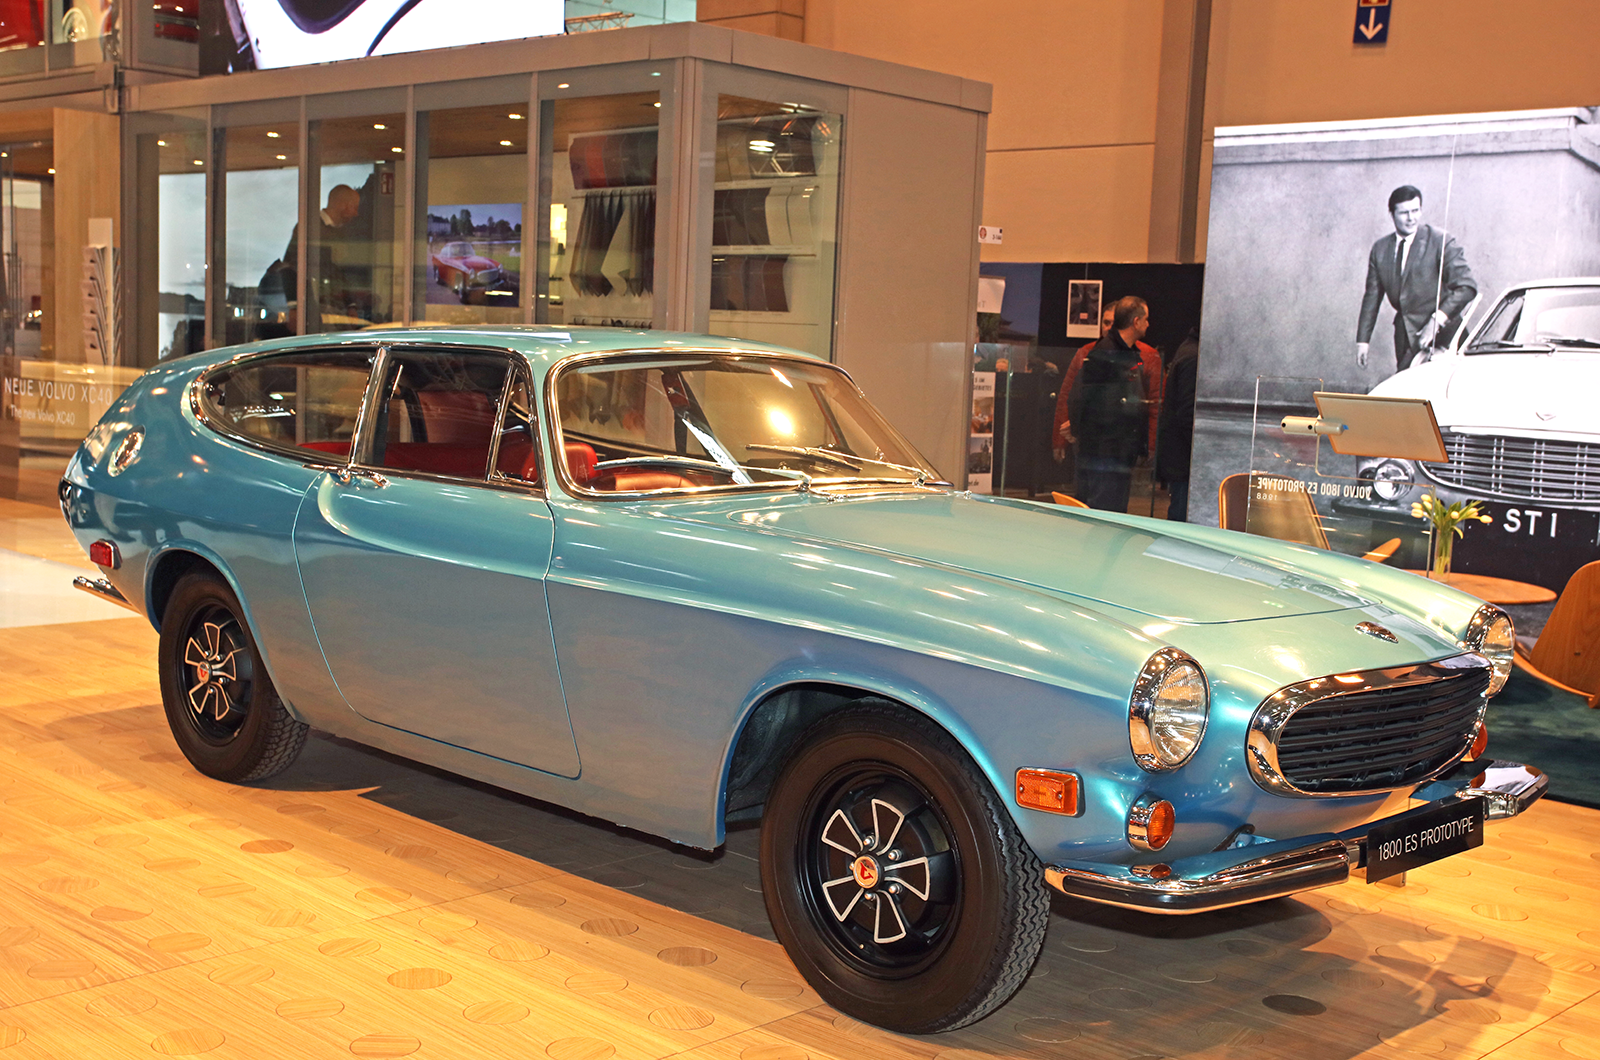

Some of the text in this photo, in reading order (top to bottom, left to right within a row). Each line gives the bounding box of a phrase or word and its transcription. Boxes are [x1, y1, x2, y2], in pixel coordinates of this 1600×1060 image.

[4, 377, 113, 406] NEUE VOLVO XC40
[10, 403, 22, 418] The
[37, 409, 55, 423] Volvo
[56, 411, 76, 426] XC40
[1378, 815, 1474, 862] 1800 ES PROTOTYPE
